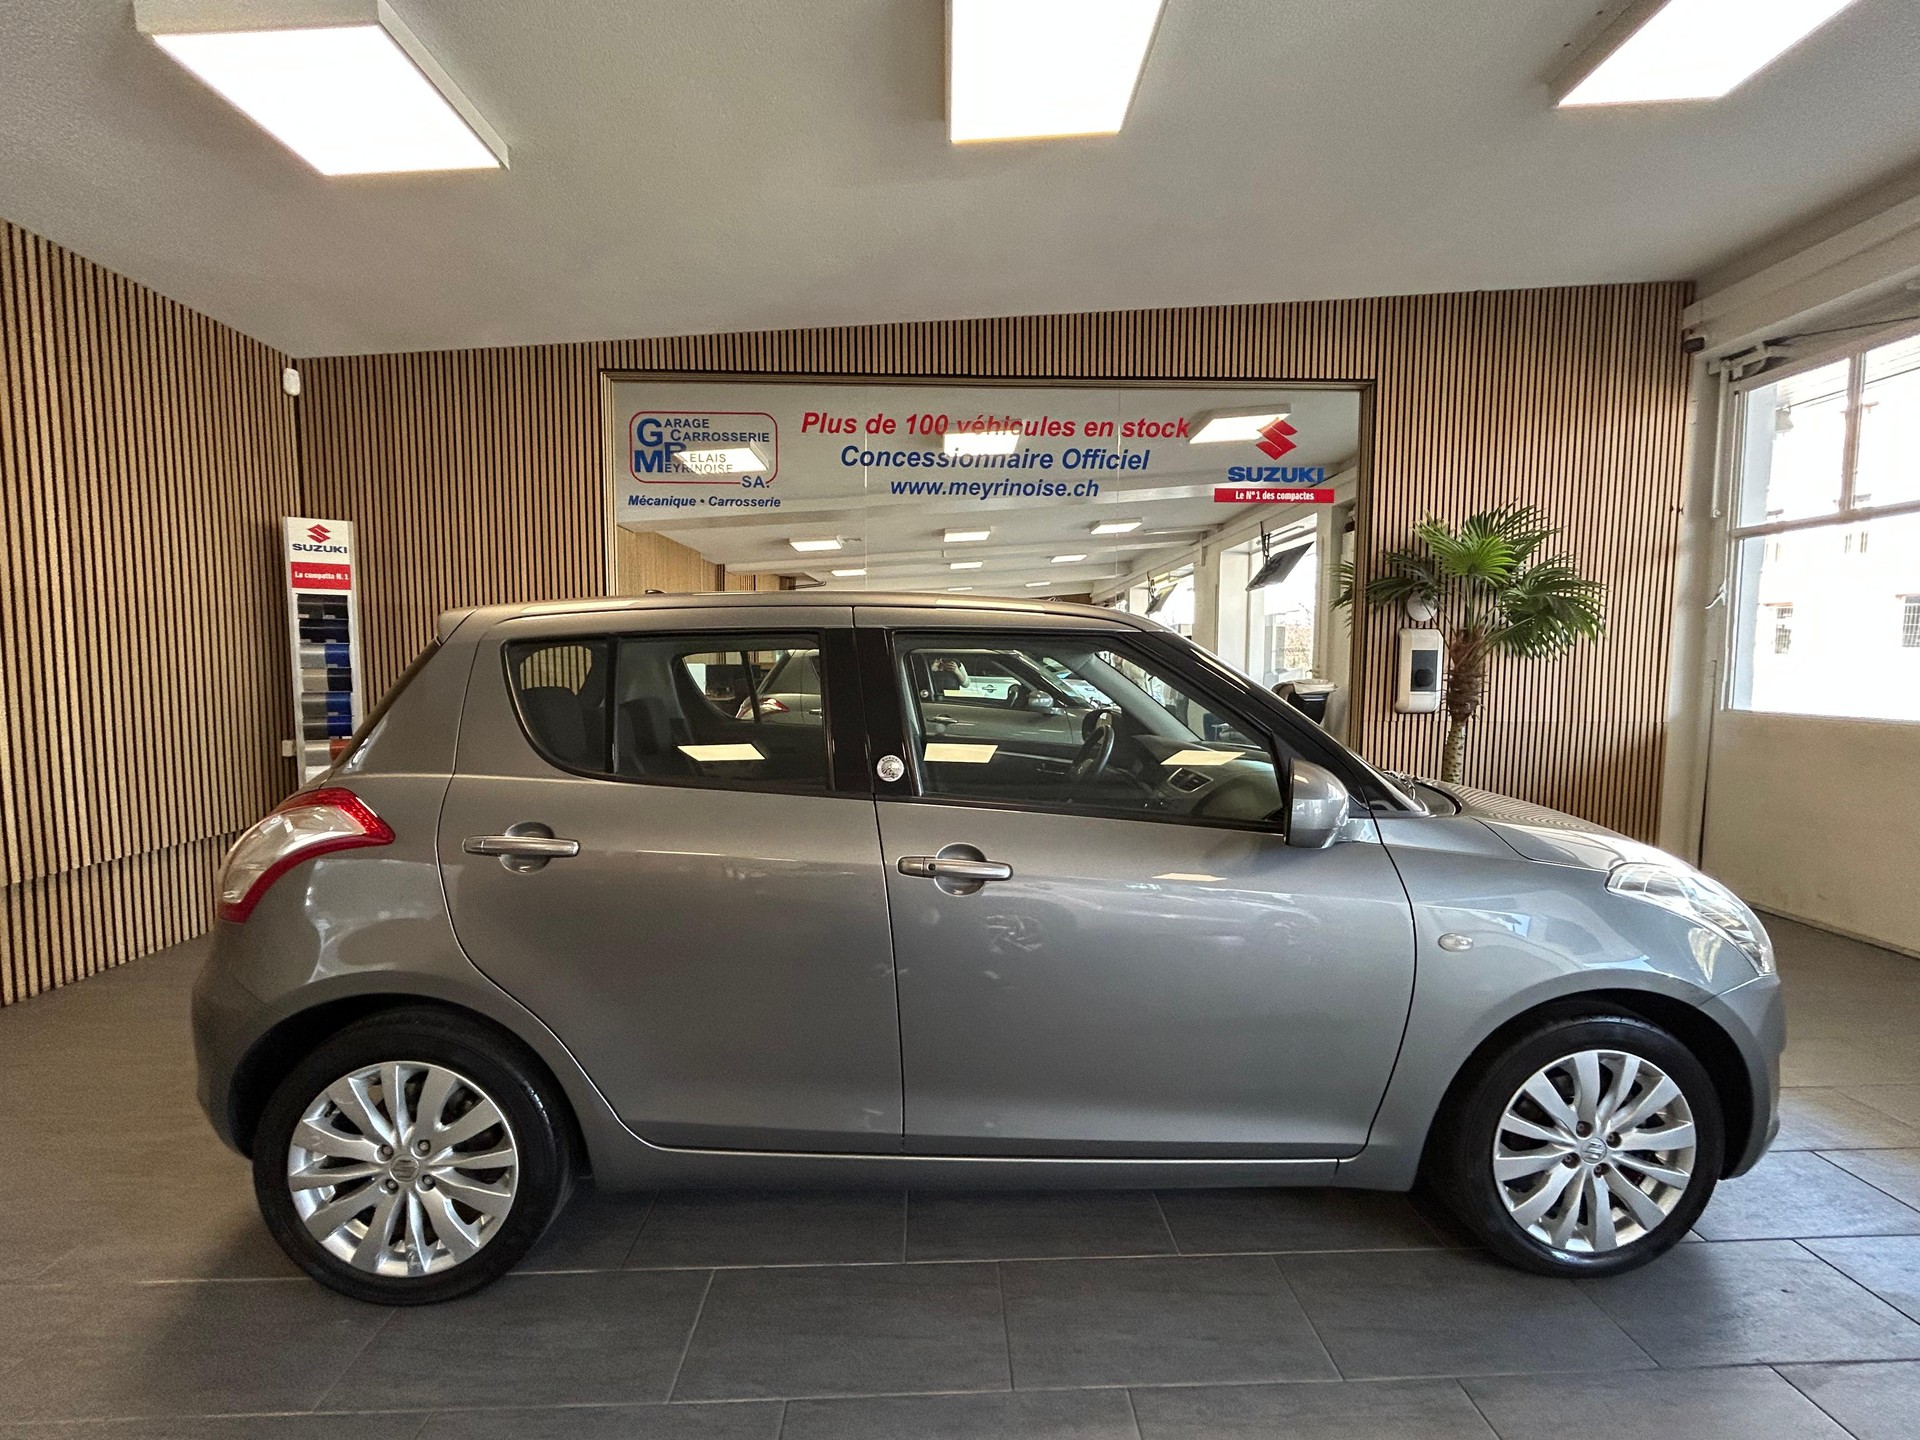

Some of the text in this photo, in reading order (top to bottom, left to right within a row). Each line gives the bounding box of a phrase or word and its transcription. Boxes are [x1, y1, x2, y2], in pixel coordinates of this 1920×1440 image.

[801, 412, 1192, 438] Plus de 100 véhicules en stock
[670, 429, 770, 443] CARROSSERIE
[841, 445, 1150, 470] Concessionnaire Officiel
[1227, 466, 1325, 484] SUZUKI
[890, 478, 1099, 500] www.meyrinoise.ch
[1235, 490, 1245, 500] Le
[1262, 490, 1275, 500] des
[1276, 491, 1315, 502] compactes
[627, 494, 781, 508] Mécanique Carrosserie
[292, 543, 348, 554] SUZUKI
